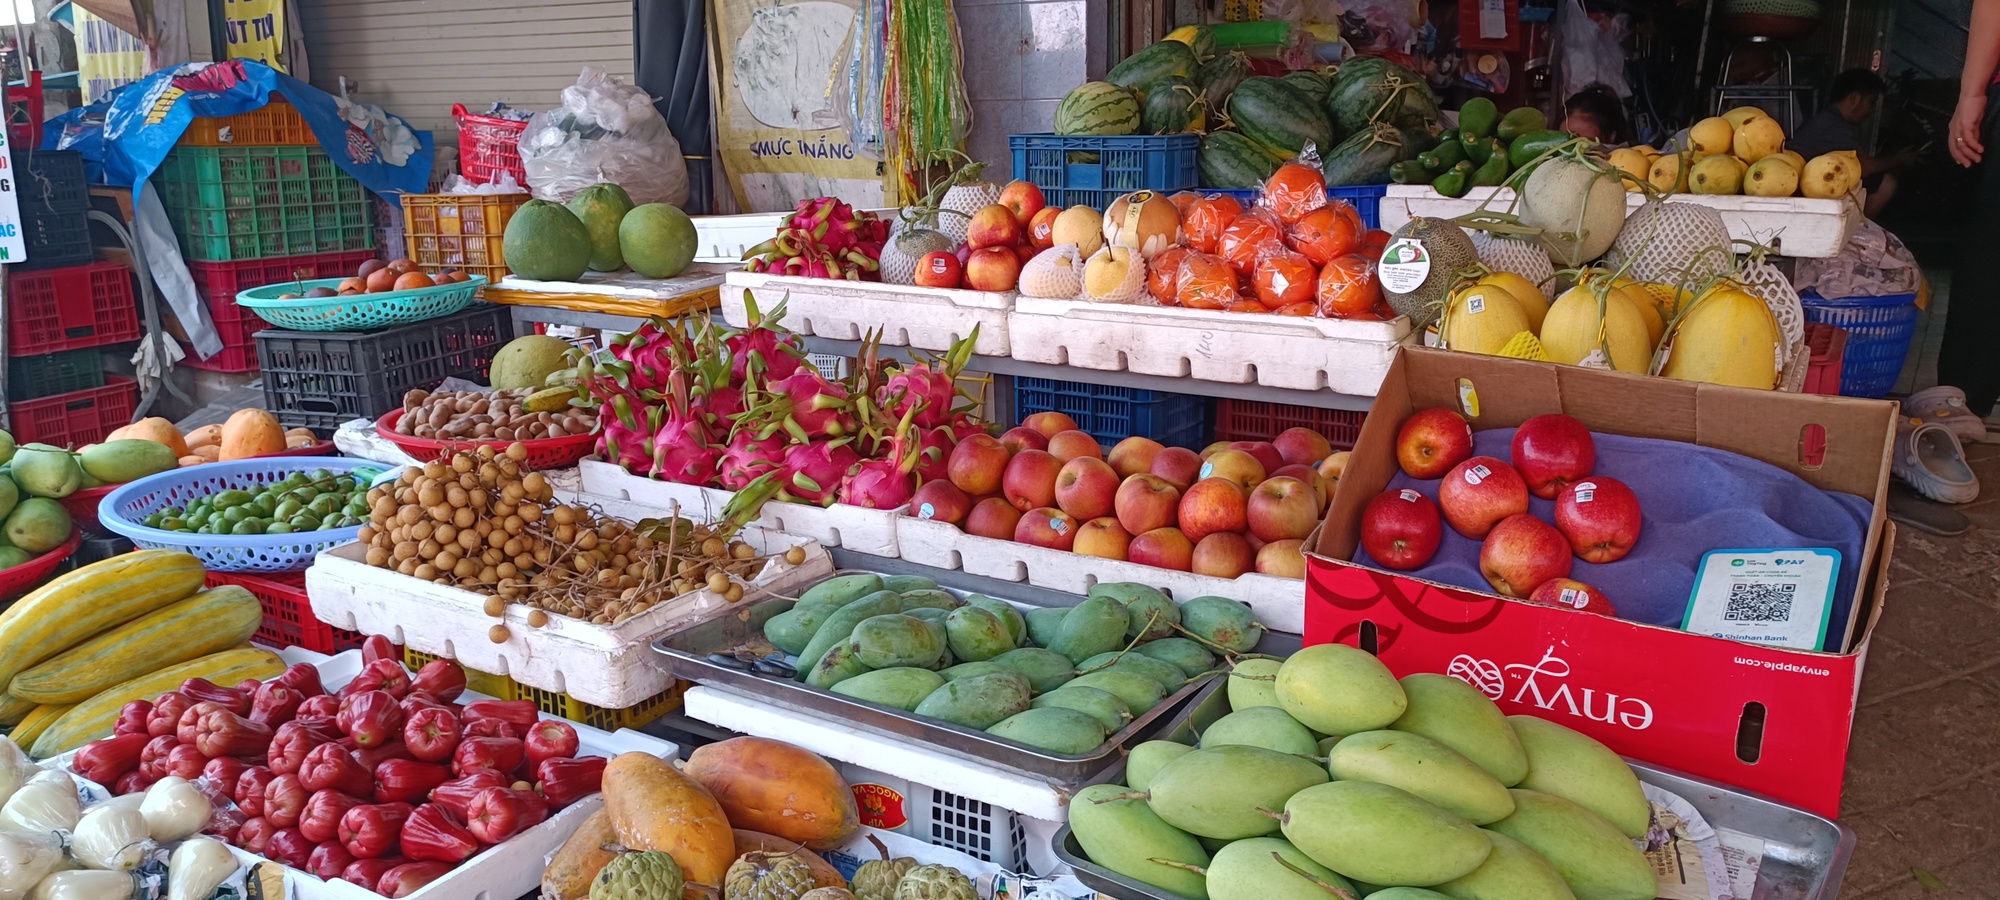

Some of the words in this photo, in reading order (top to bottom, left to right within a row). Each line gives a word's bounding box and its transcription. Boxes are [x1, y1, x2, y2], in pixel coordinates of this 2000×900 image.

[757, 137, 792, 159] MỰC
[803, 134, 854, 160] NẮNG
[1724, 633, 1762, 641] Shinhan
[1734, 656, 1829, 676] envyapple.com
[1504, 646, 1654, 731] envy
[868, 819, 885, 828] VIP
